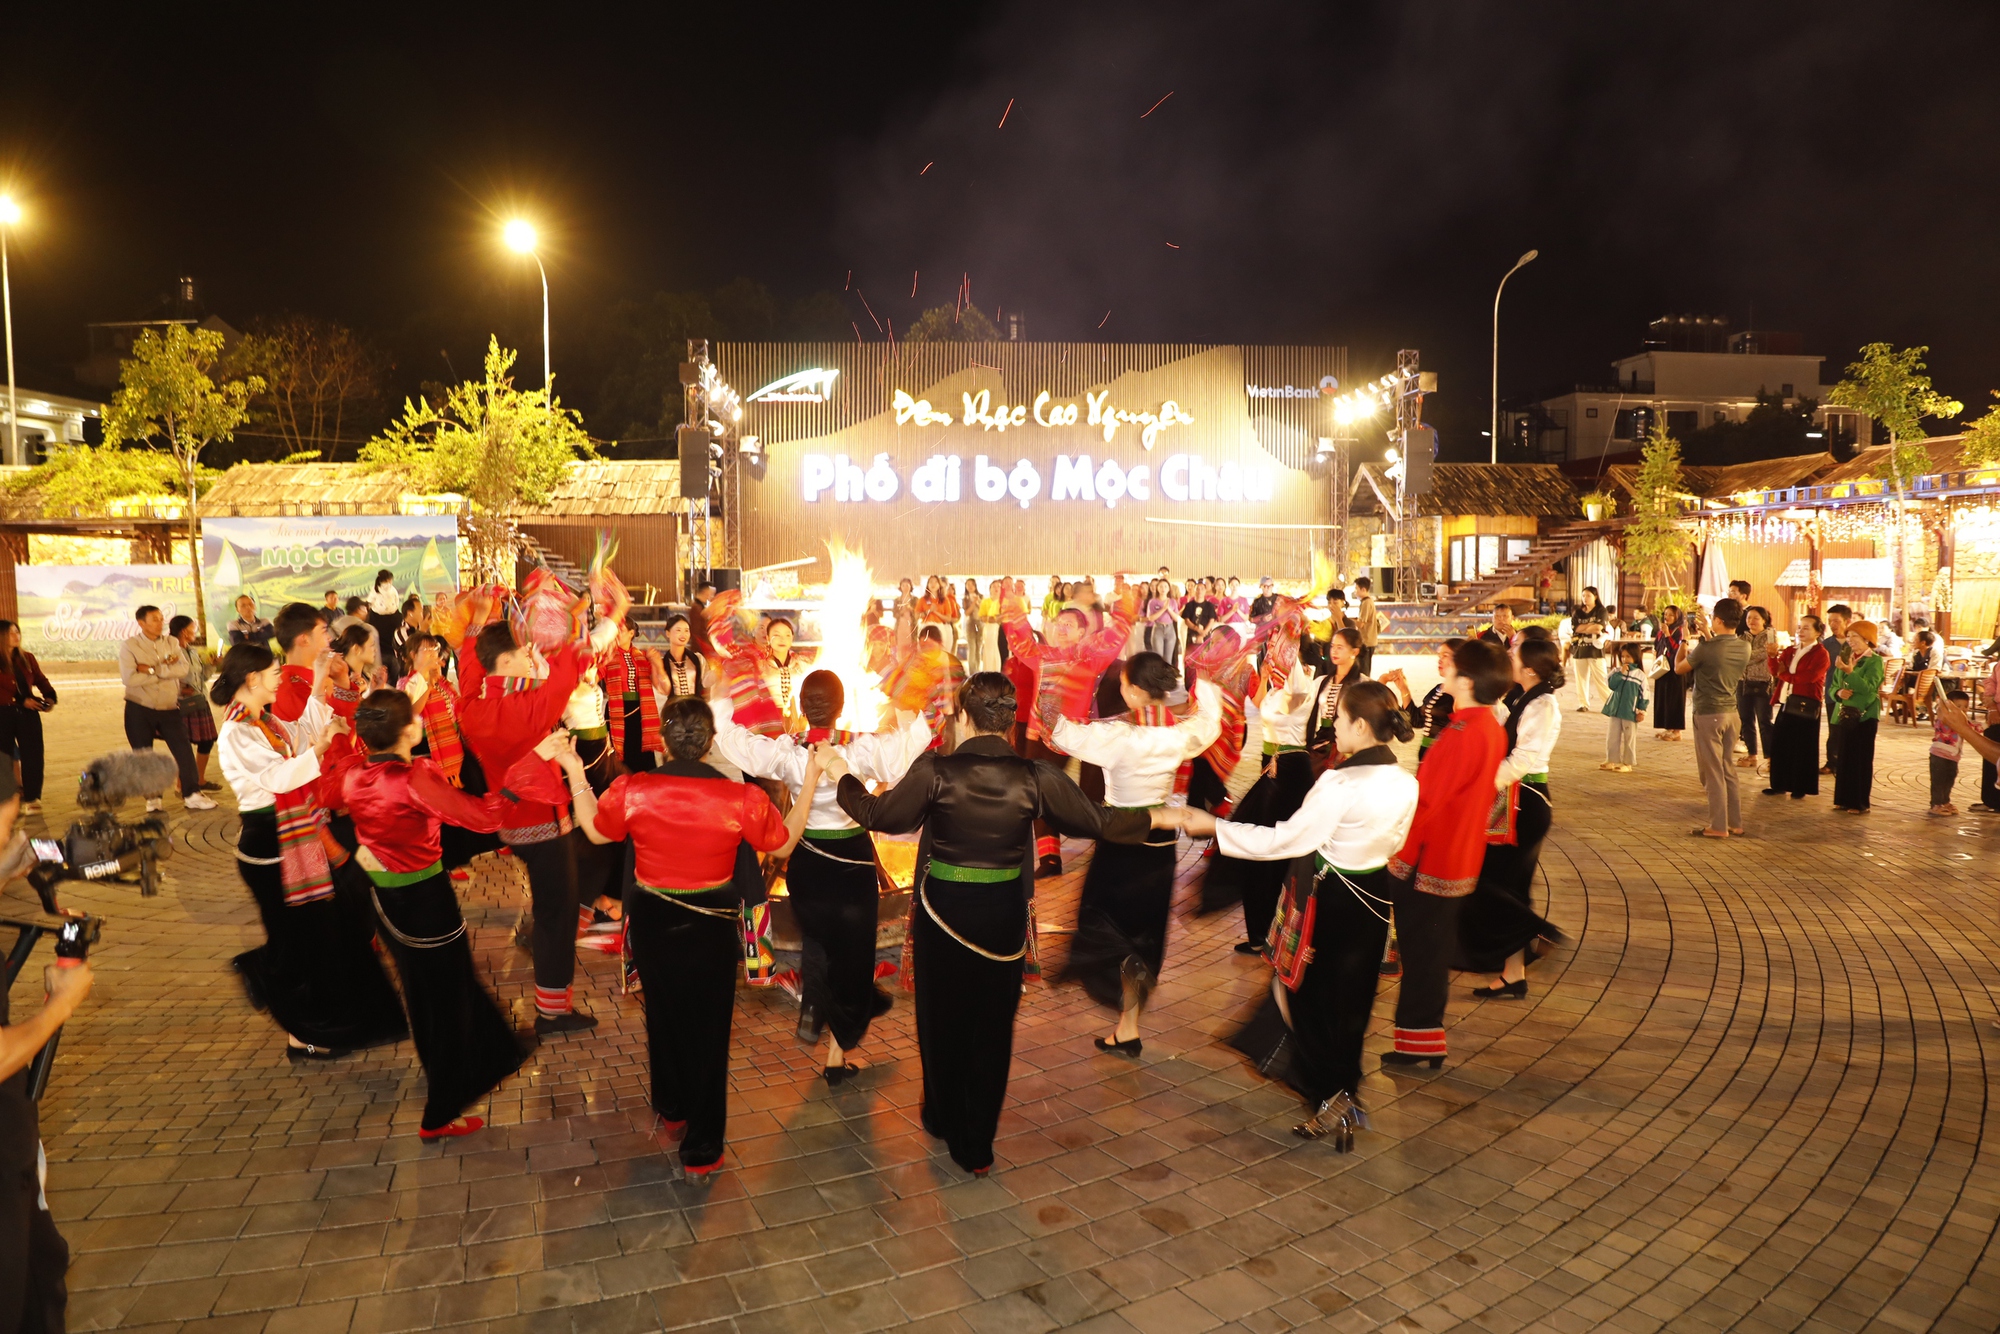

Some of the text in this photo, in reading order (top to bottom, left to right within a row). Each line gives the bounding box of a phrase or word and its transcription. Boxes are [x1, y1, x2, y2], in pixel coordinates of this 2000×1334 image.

[1033, 389, 1079, 428] Cao
[802, 452, 898, 502] Phố
[911, 453, 961, 502] đi
[974, 454, 1041, 509] bộ
[1051, 454, 1150, 509] Mộc
[261, 542, 400, 573] MỘC CHÂU
